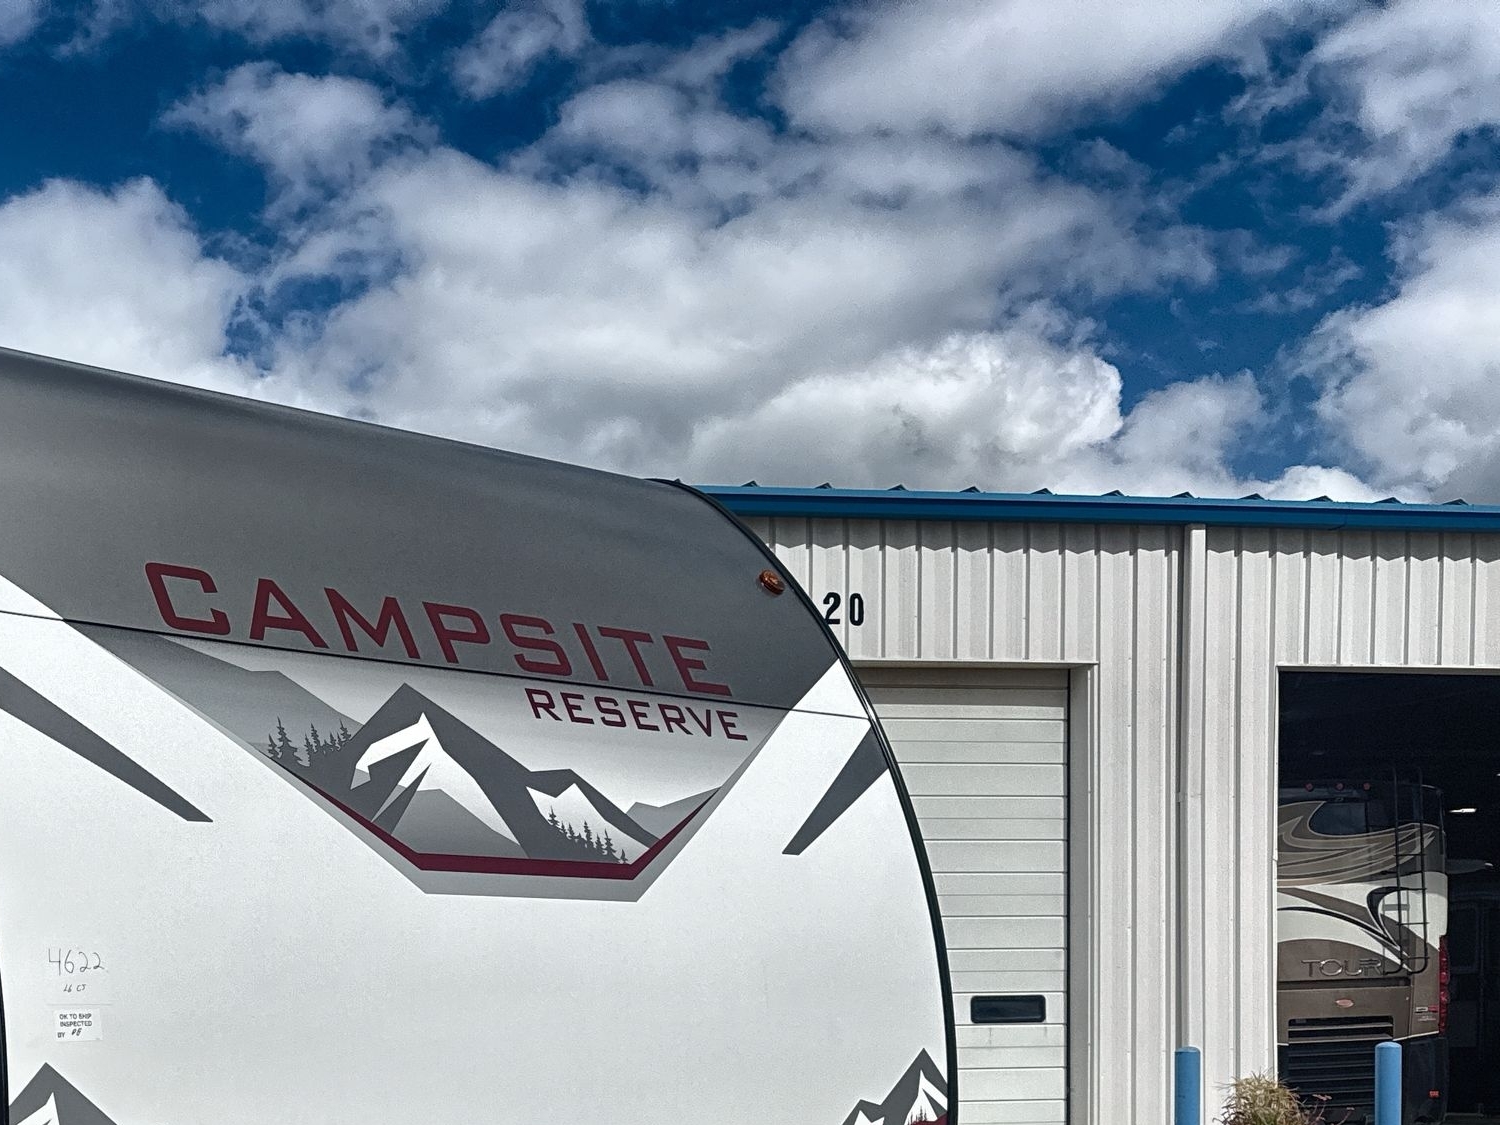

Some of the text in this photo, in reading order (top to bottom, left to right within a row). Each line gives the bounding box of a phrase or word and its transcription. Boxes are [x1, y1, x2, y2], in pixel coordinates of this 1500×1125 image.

[144, 561, 733, 697] CAMPSITE
[822, 591, 865, 626] 20
[524, 688, 748, 741] RESERVE
[47, 947, 106, 976] 4622
